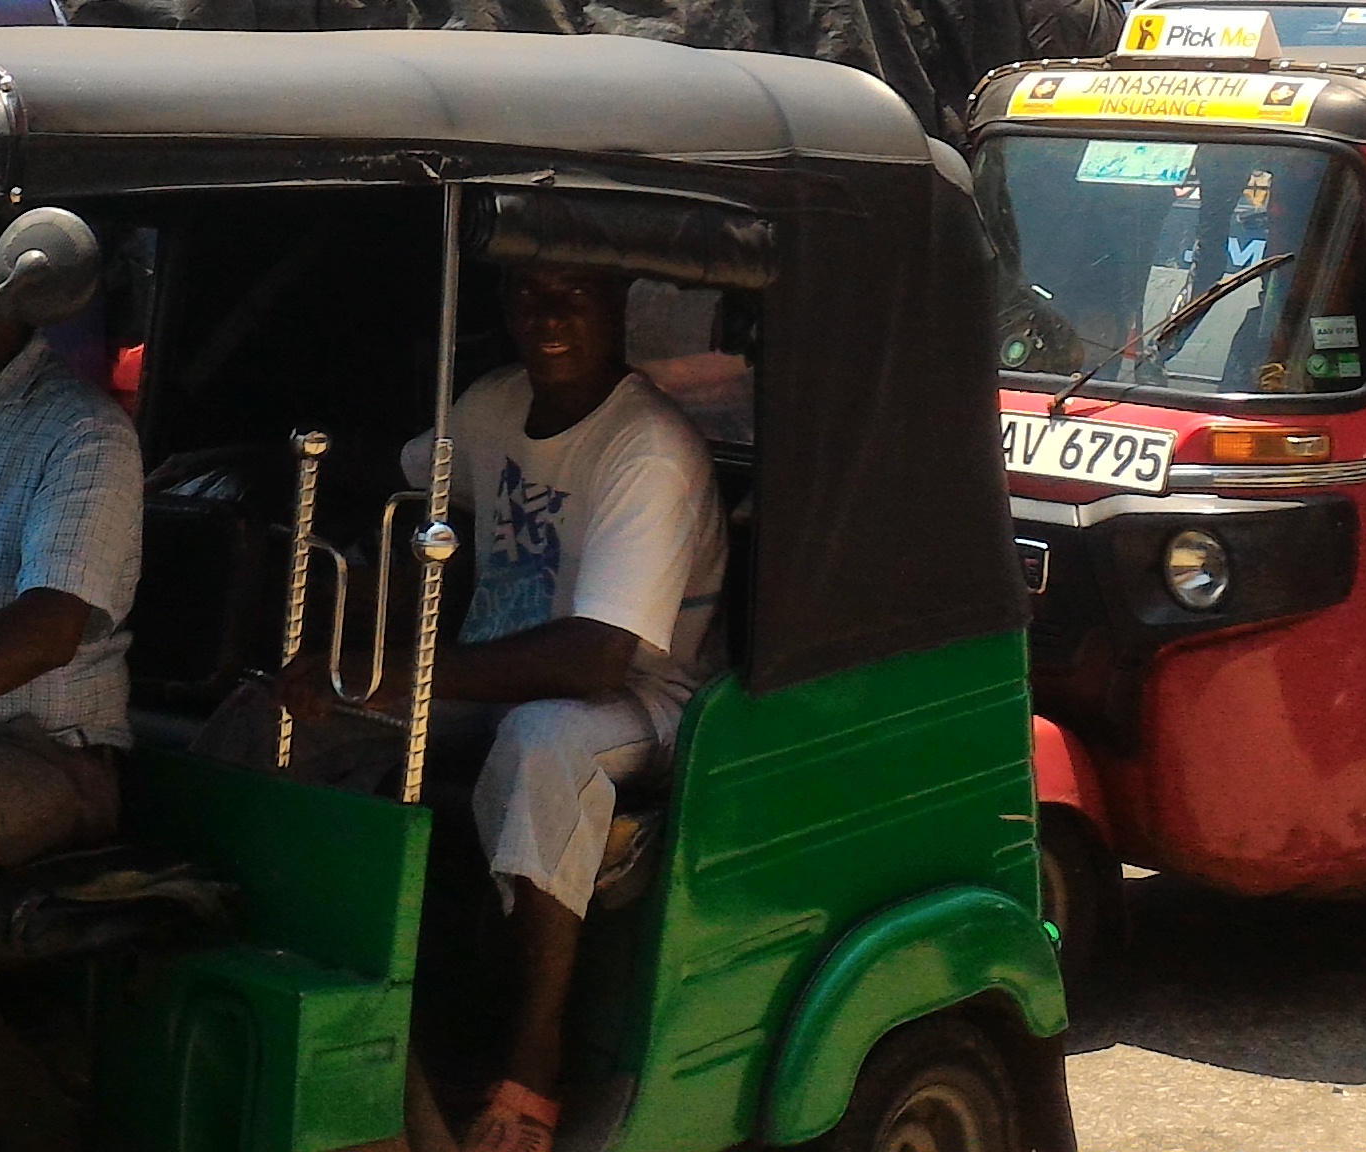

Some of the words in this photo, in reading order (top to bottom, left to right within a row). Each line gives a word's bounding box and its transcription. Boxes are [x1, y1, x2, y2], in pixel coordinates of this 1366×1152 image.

[1165, 24, 1216, 48] Pick
[1219, 26, 1257, 48] Me
[1082, 75, 1249, 98] JANASHAKTHI
[1098, 98, 1208, 118] INSURANCE
[1059, 428, 1168, 482] 6795
